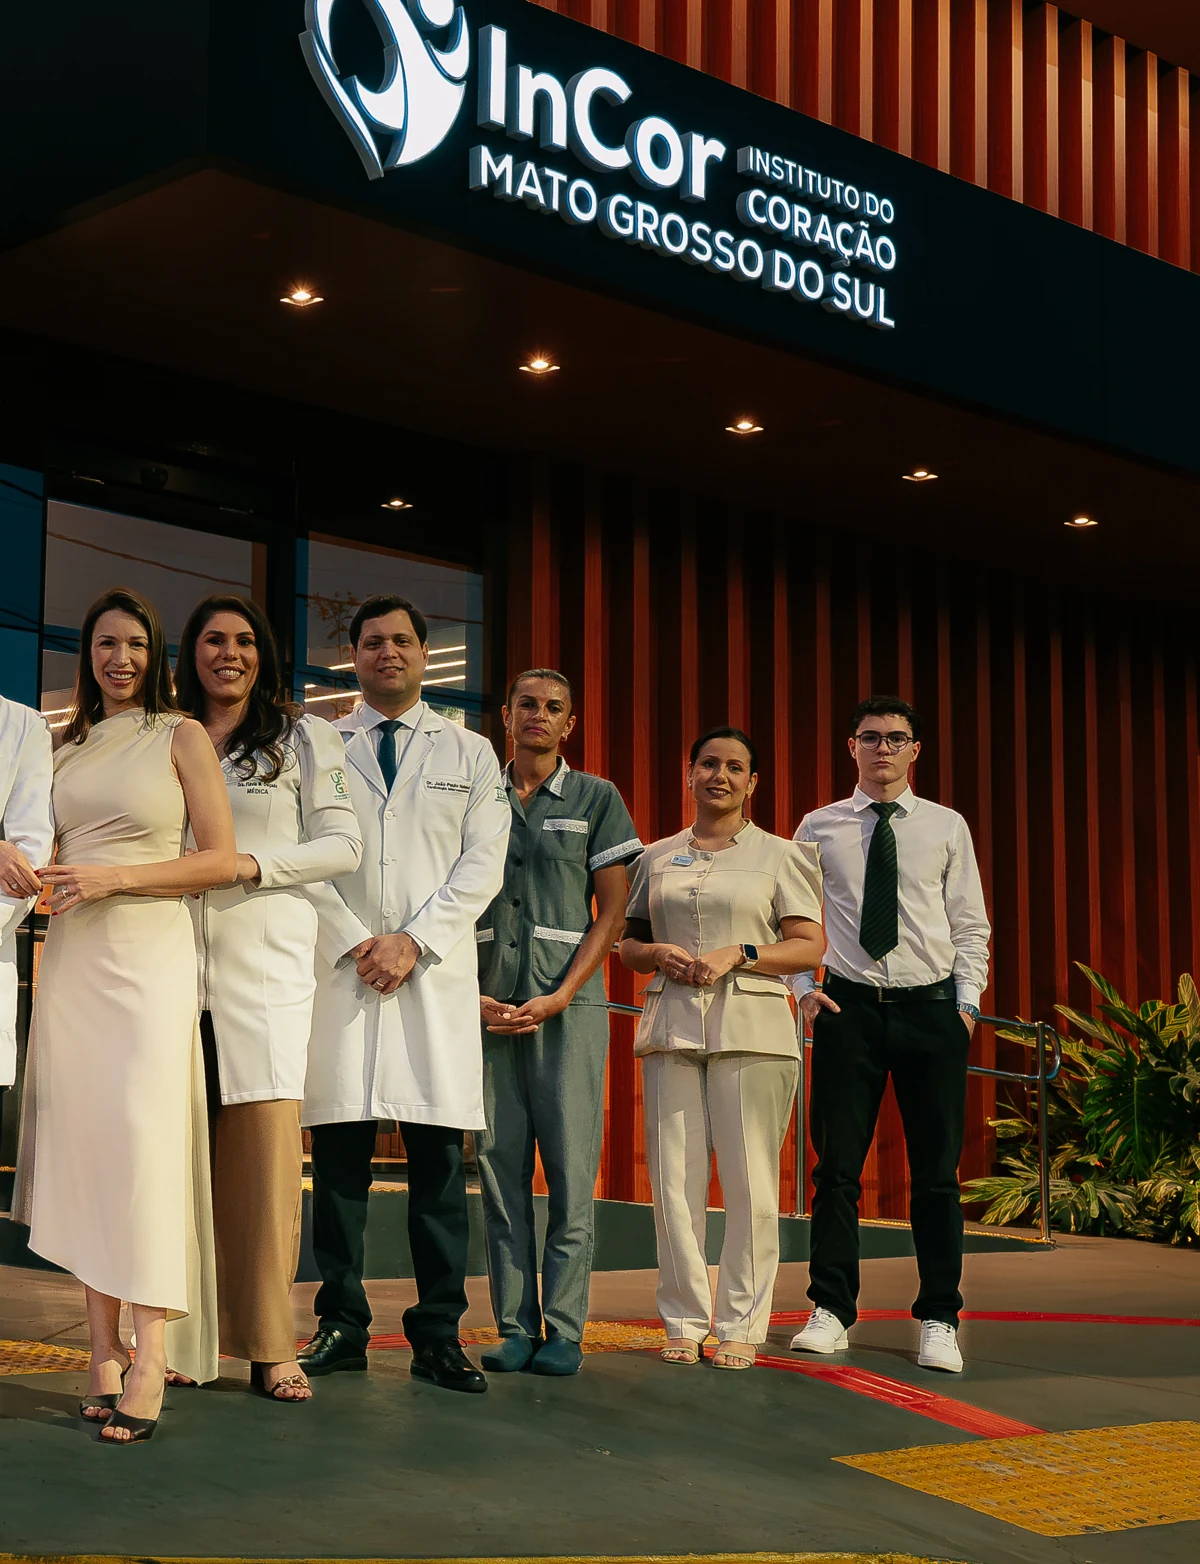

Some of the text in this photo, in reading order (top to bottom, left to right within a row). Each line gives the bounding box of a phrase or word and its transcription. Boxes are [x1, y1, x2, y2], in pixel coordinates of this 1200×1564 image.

[487, 24, 727, 200] InCor
[748, 146, 896, 225] INSTITUTO DO
[479, 145, 896, 329] MATO GROSSO DO SUL
[745, 188, 897, 272] CORAÇÃO
[246, 787, 269, 795] MÉDICA
